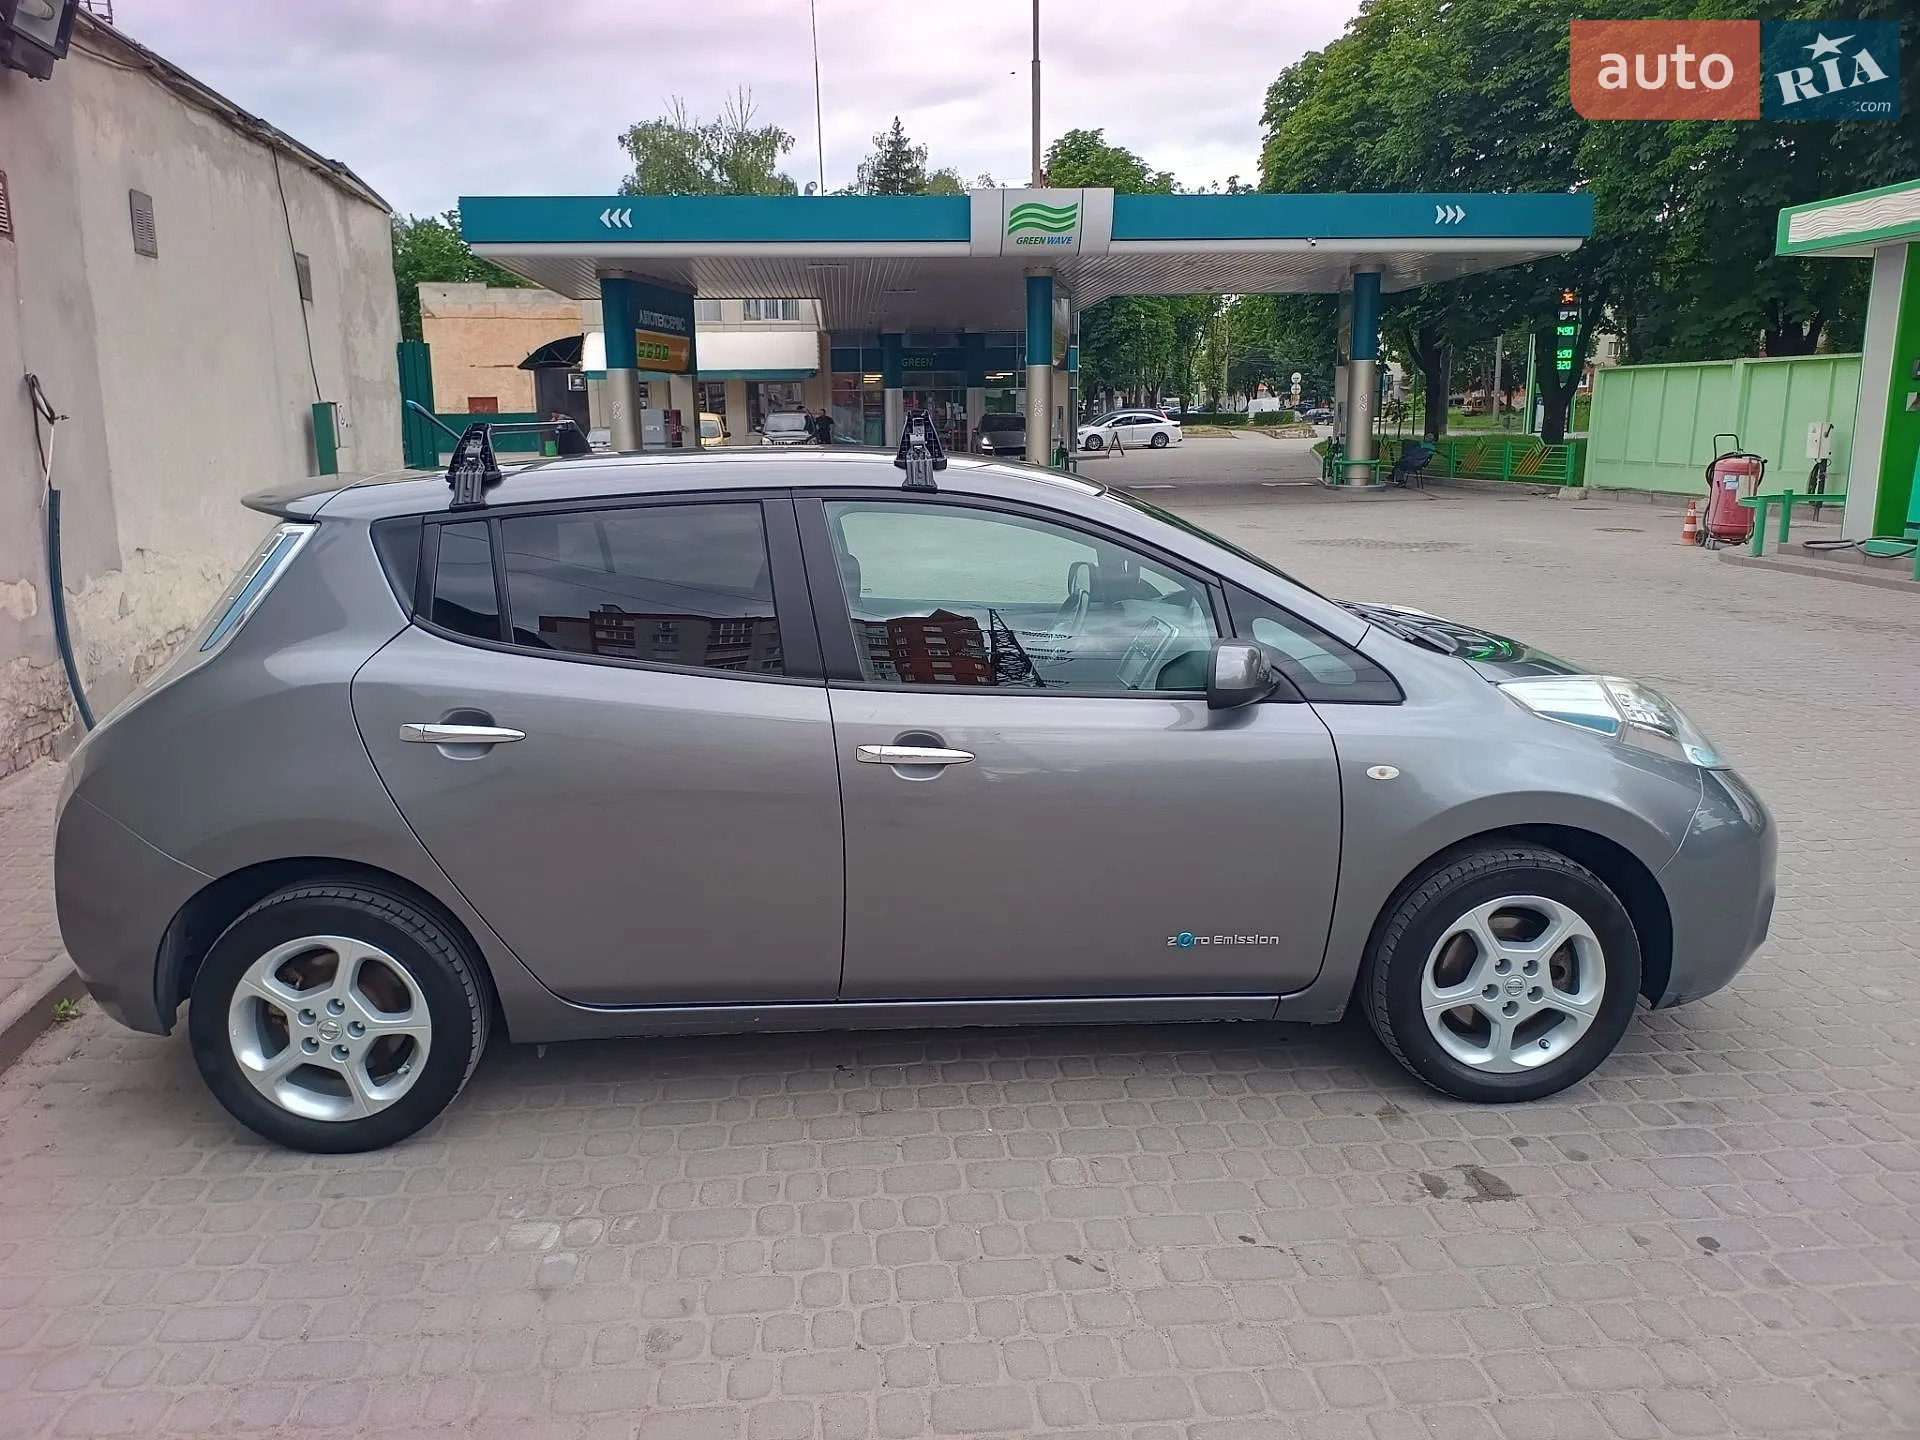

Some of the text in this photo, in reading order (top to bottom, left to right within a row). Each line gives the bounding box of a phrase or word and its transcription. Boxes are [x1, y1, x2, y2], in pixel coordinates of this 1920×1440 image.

[1016, 236, 1073, 245] GREEN WAVE
[902, 357, 934, 367] GREEN
[1213, 934, 1280, 945] Emission
